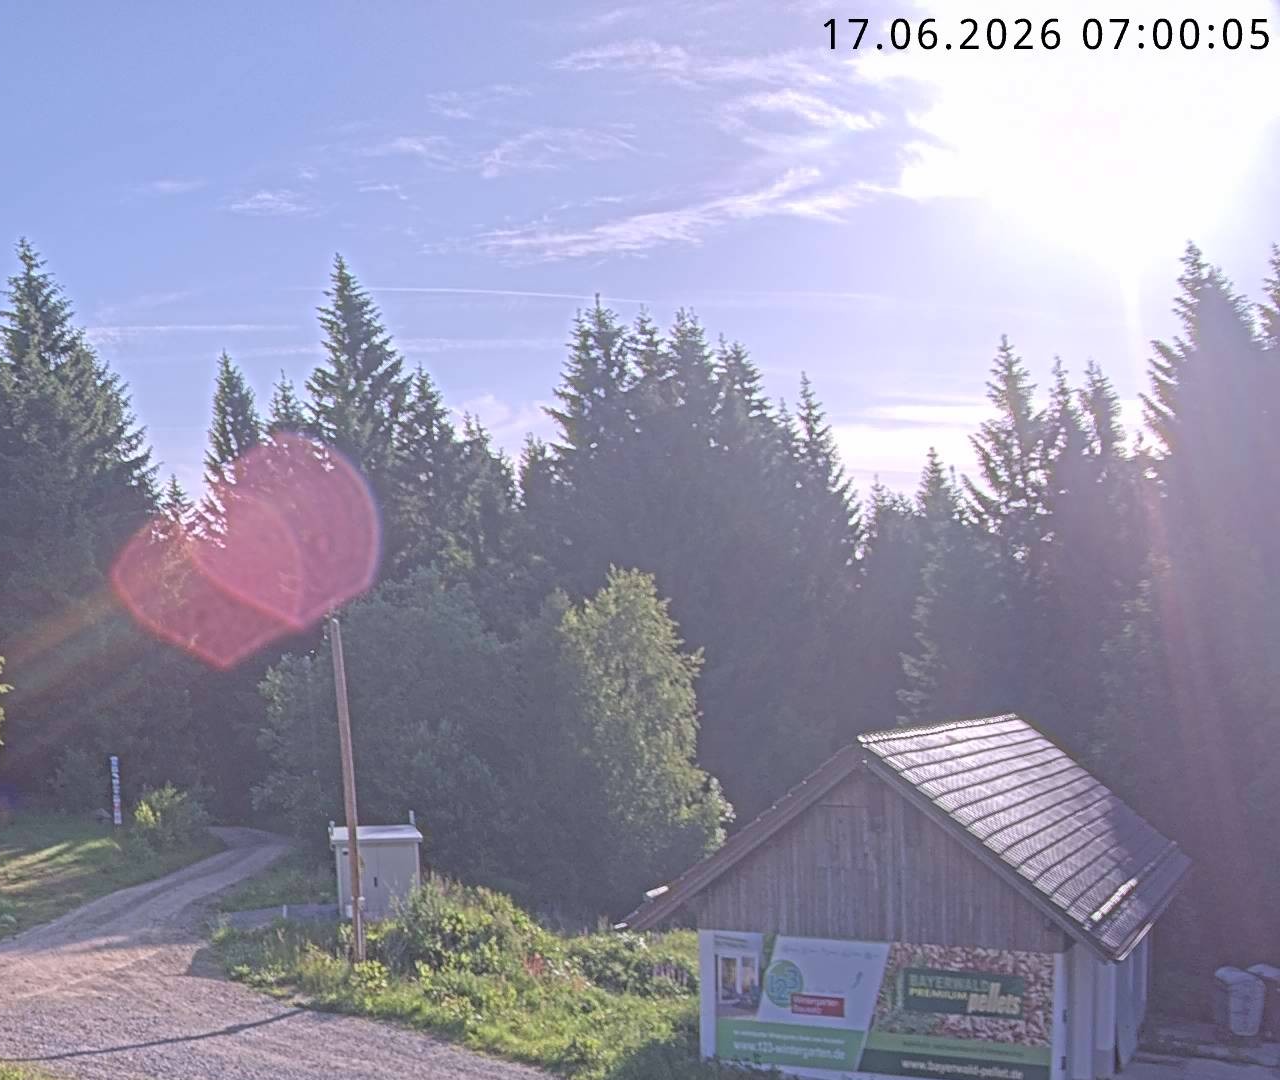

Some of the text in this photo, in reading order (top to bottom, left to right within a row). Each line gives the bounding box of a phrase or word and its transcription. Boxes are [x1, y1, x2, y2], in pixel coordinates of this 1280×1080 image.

[909, 974, 991, 992] BAYERWALD
[909, 987, 968, 1000] PREMIUM
[966, 982, 1022, 1014] pellets
